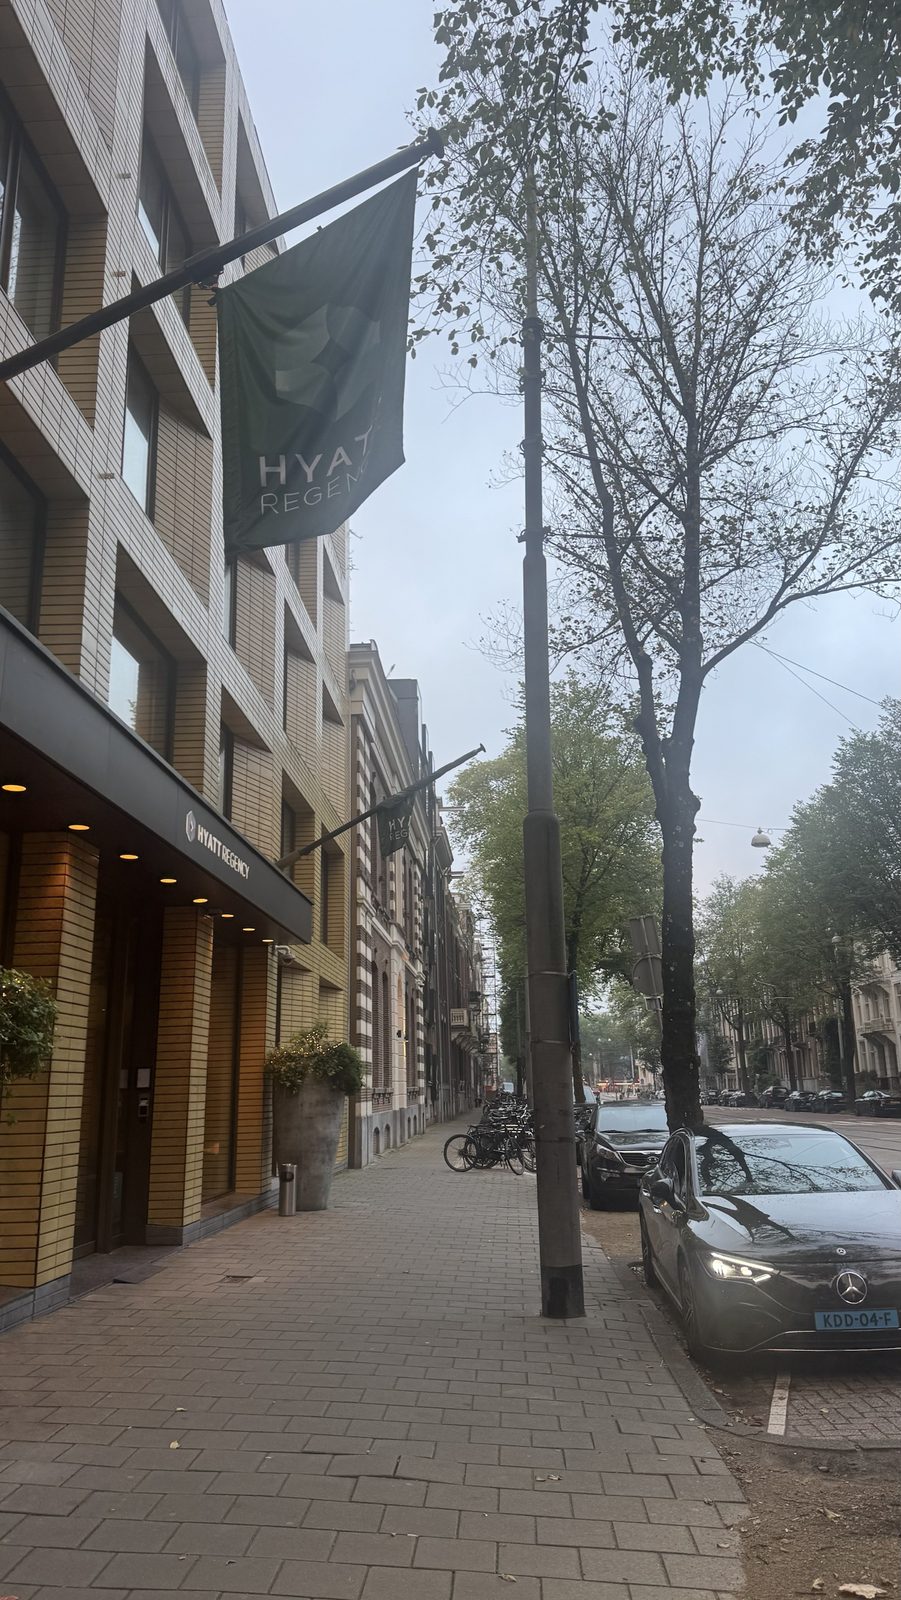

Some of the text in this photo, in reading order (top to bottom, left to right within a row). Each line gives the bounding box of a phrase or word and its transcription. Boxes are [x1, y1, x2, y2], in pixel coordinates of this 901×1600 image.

[259, 424, 373, 487] HYAT
[261, 463, 365, 515] REGEN
[197, 824, 250, 880] HYATT REGENCY
[823, 1311, 892, 1328] KDD-04-F
